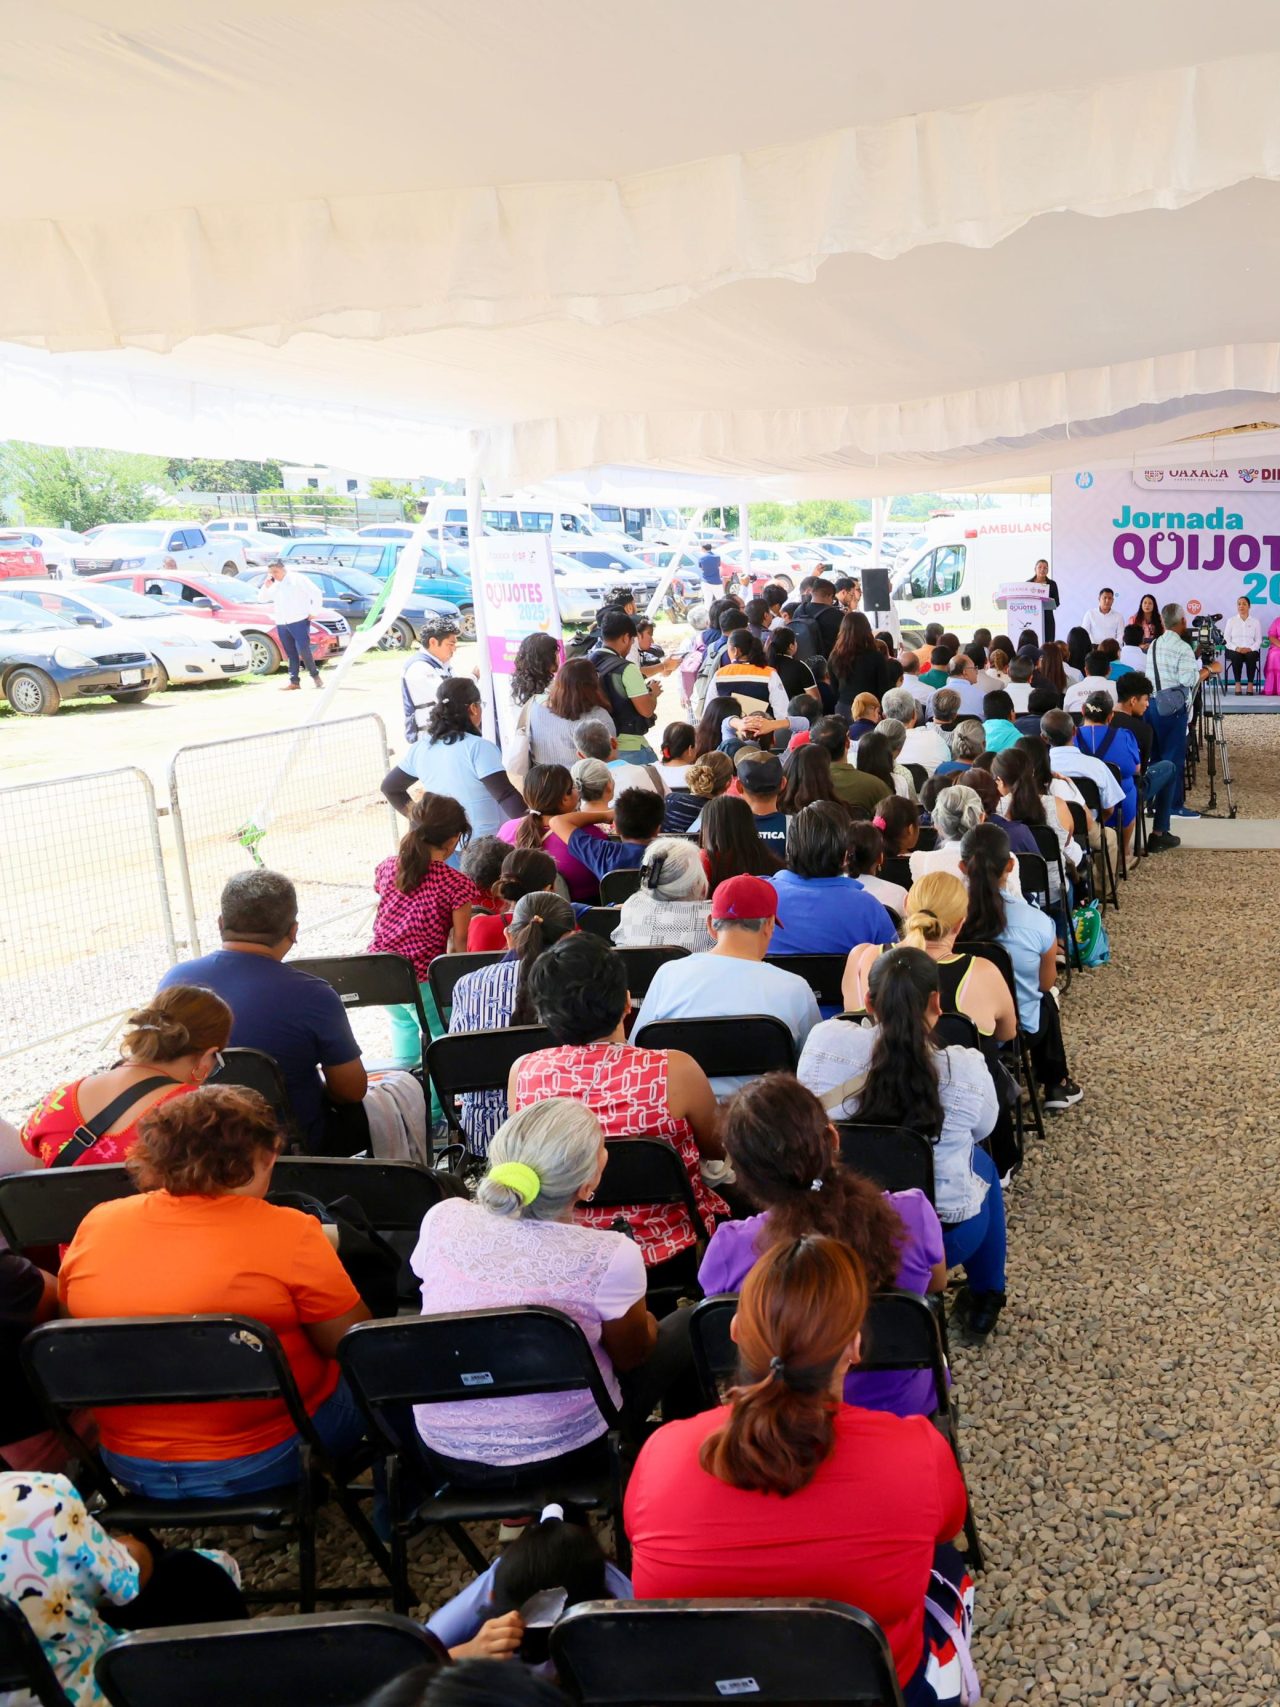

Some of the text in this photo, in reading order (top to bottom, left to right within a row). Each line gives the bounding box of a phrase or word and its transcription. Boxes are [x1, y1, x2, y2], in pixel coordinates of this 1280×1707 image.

[1112, 505, 1243, 529] Jornada
[486, 583, 543, 609] QUIJOTES
[933, 602, 952, 612] DIF
